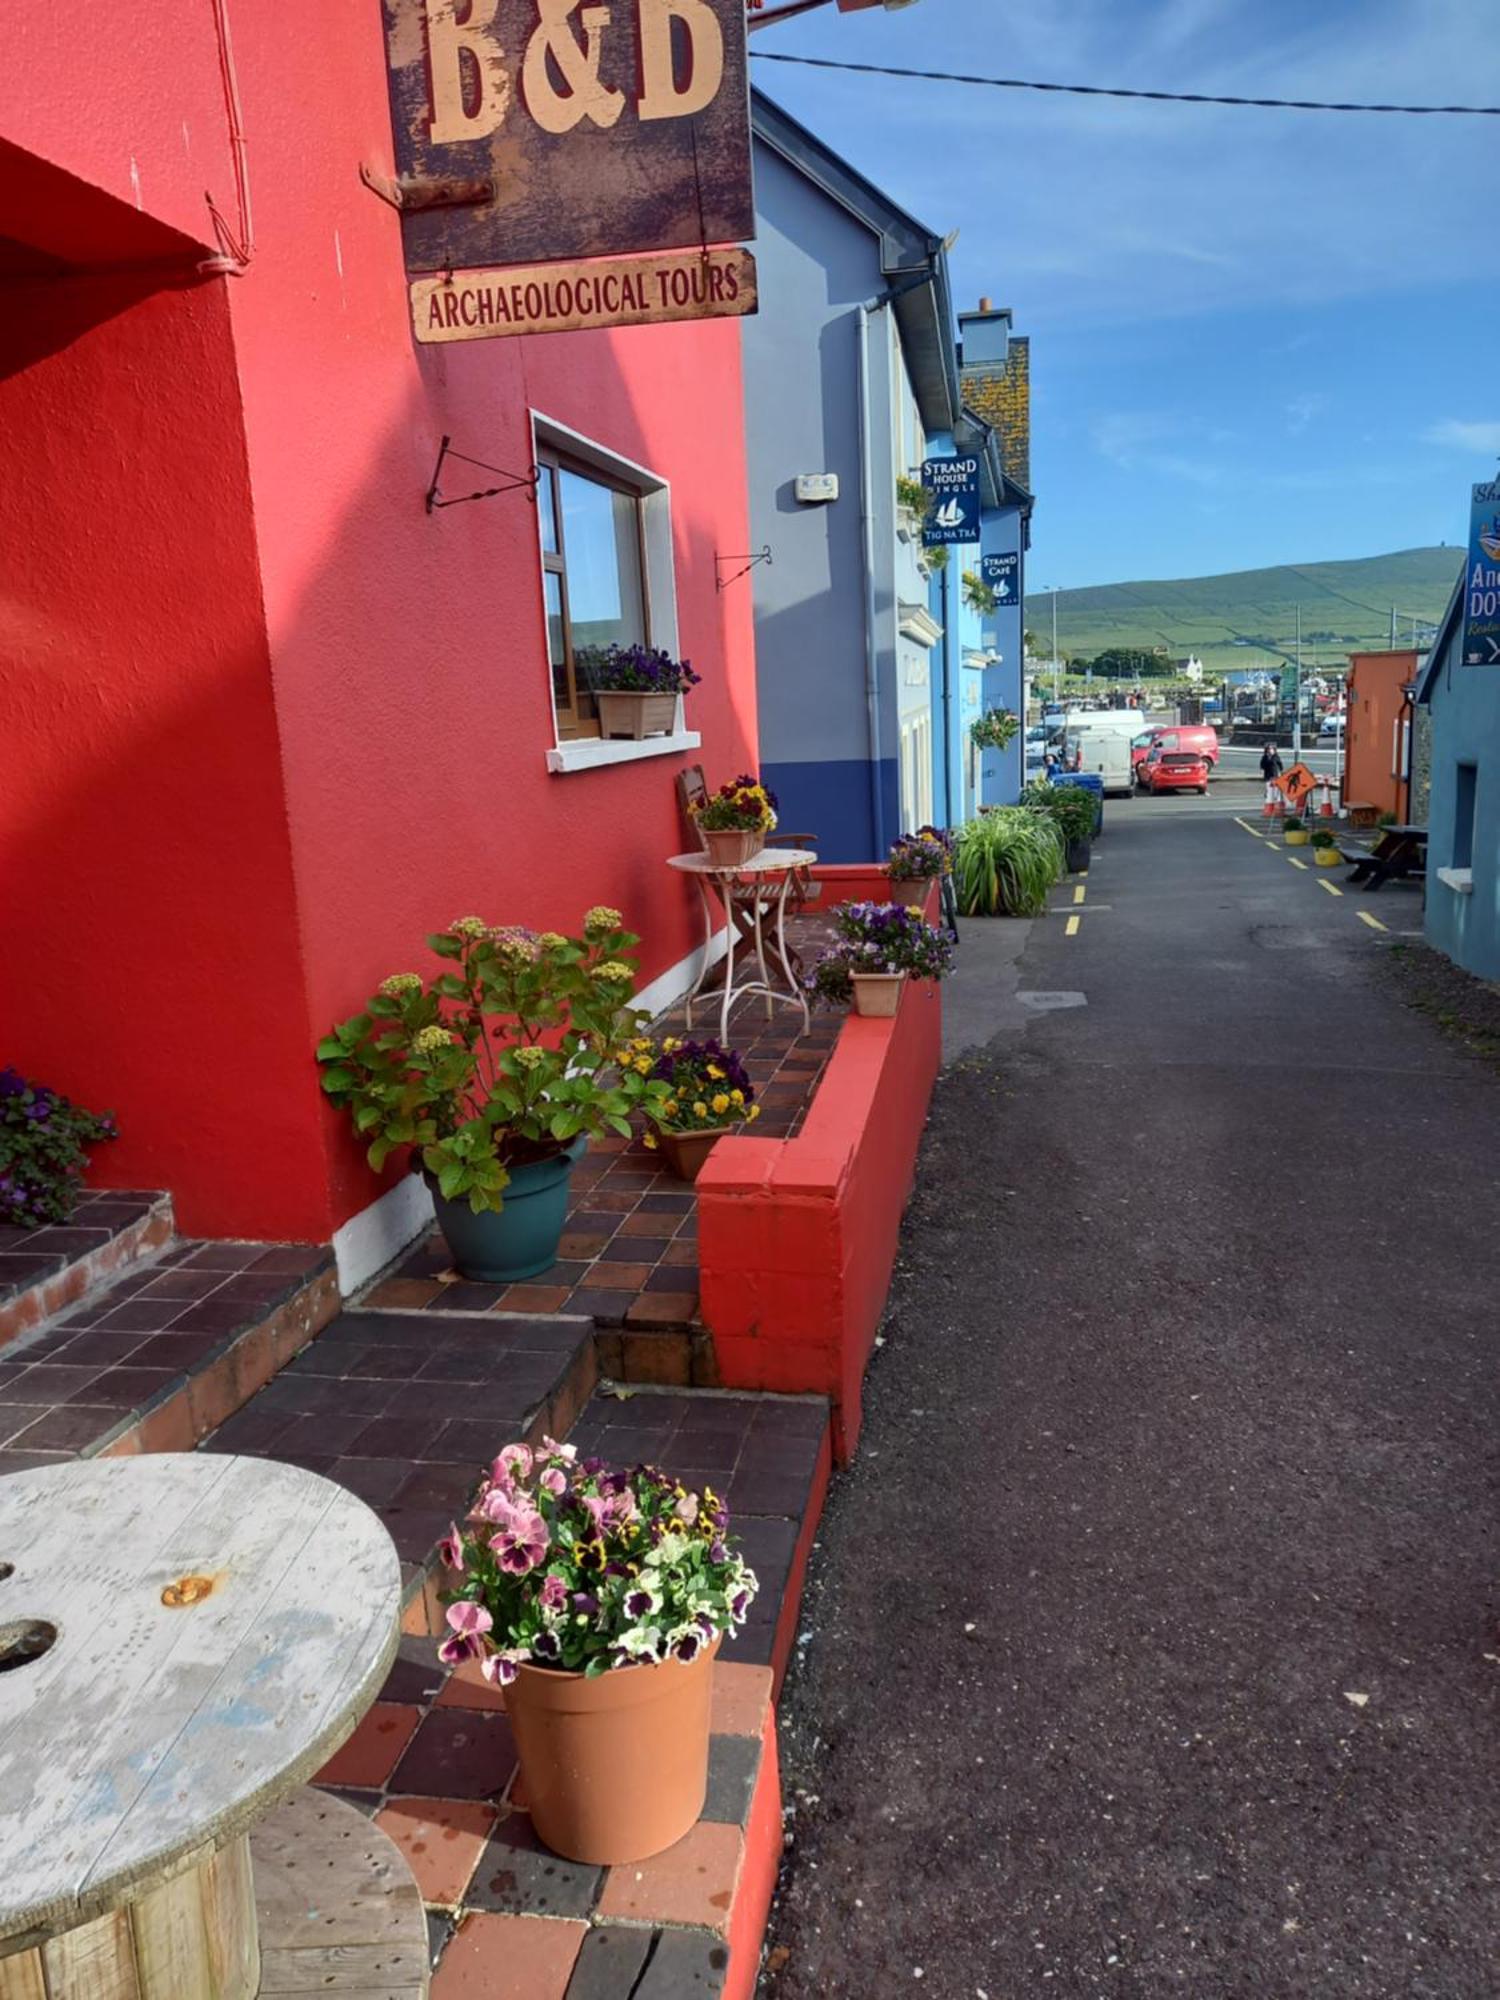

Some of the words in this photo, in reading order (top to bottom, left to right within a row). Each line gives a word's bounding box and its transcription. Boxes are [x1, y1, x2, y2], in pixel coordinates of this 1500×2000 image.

[429, 272, 650, 329] ARCHAEOLOGICAL
[656, 265, 738, 306] TOURS
[924, 459, 977, 476] STRAND
[933, 473, 968, 484] HOUSE
[925, 530, 941, 540] TIG
[943, 530, 957, 539] NA
[983, 555, 1017, 567] STRAND
